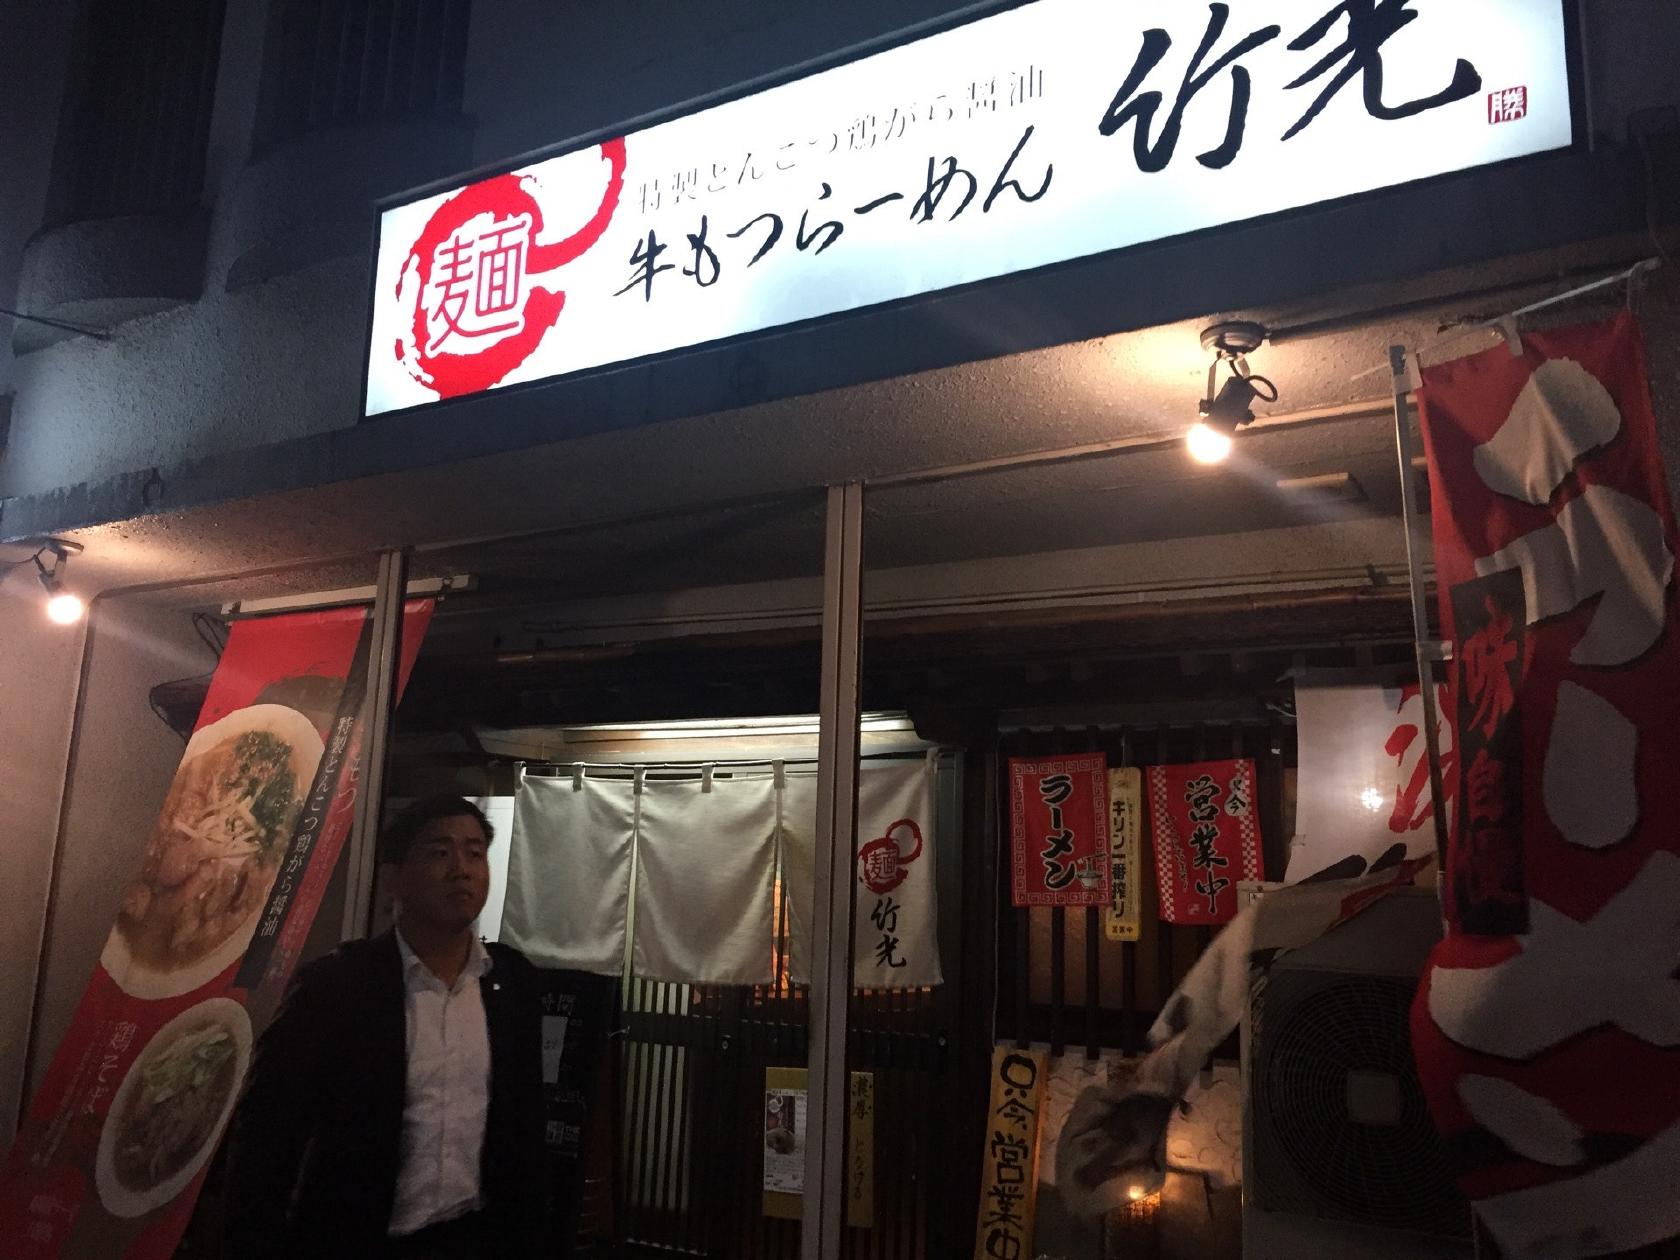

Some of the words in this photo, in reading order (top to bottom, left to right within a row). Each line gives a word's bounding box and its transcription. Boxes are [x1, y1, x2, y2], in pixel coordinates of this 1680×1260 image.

[1100, 0, 1482, 173] 竹光
[424, 213, 532, 354] 麺
[612, 125, 1053, 302] 牛もつらーめん
[1039, 773, 1077, 890] ラーメン
[1111, 799, 1128, 920] キリン一番搾り
[1183, 774, 1232, 917] 営業中
[871, 896, 907, 969] 竹光
